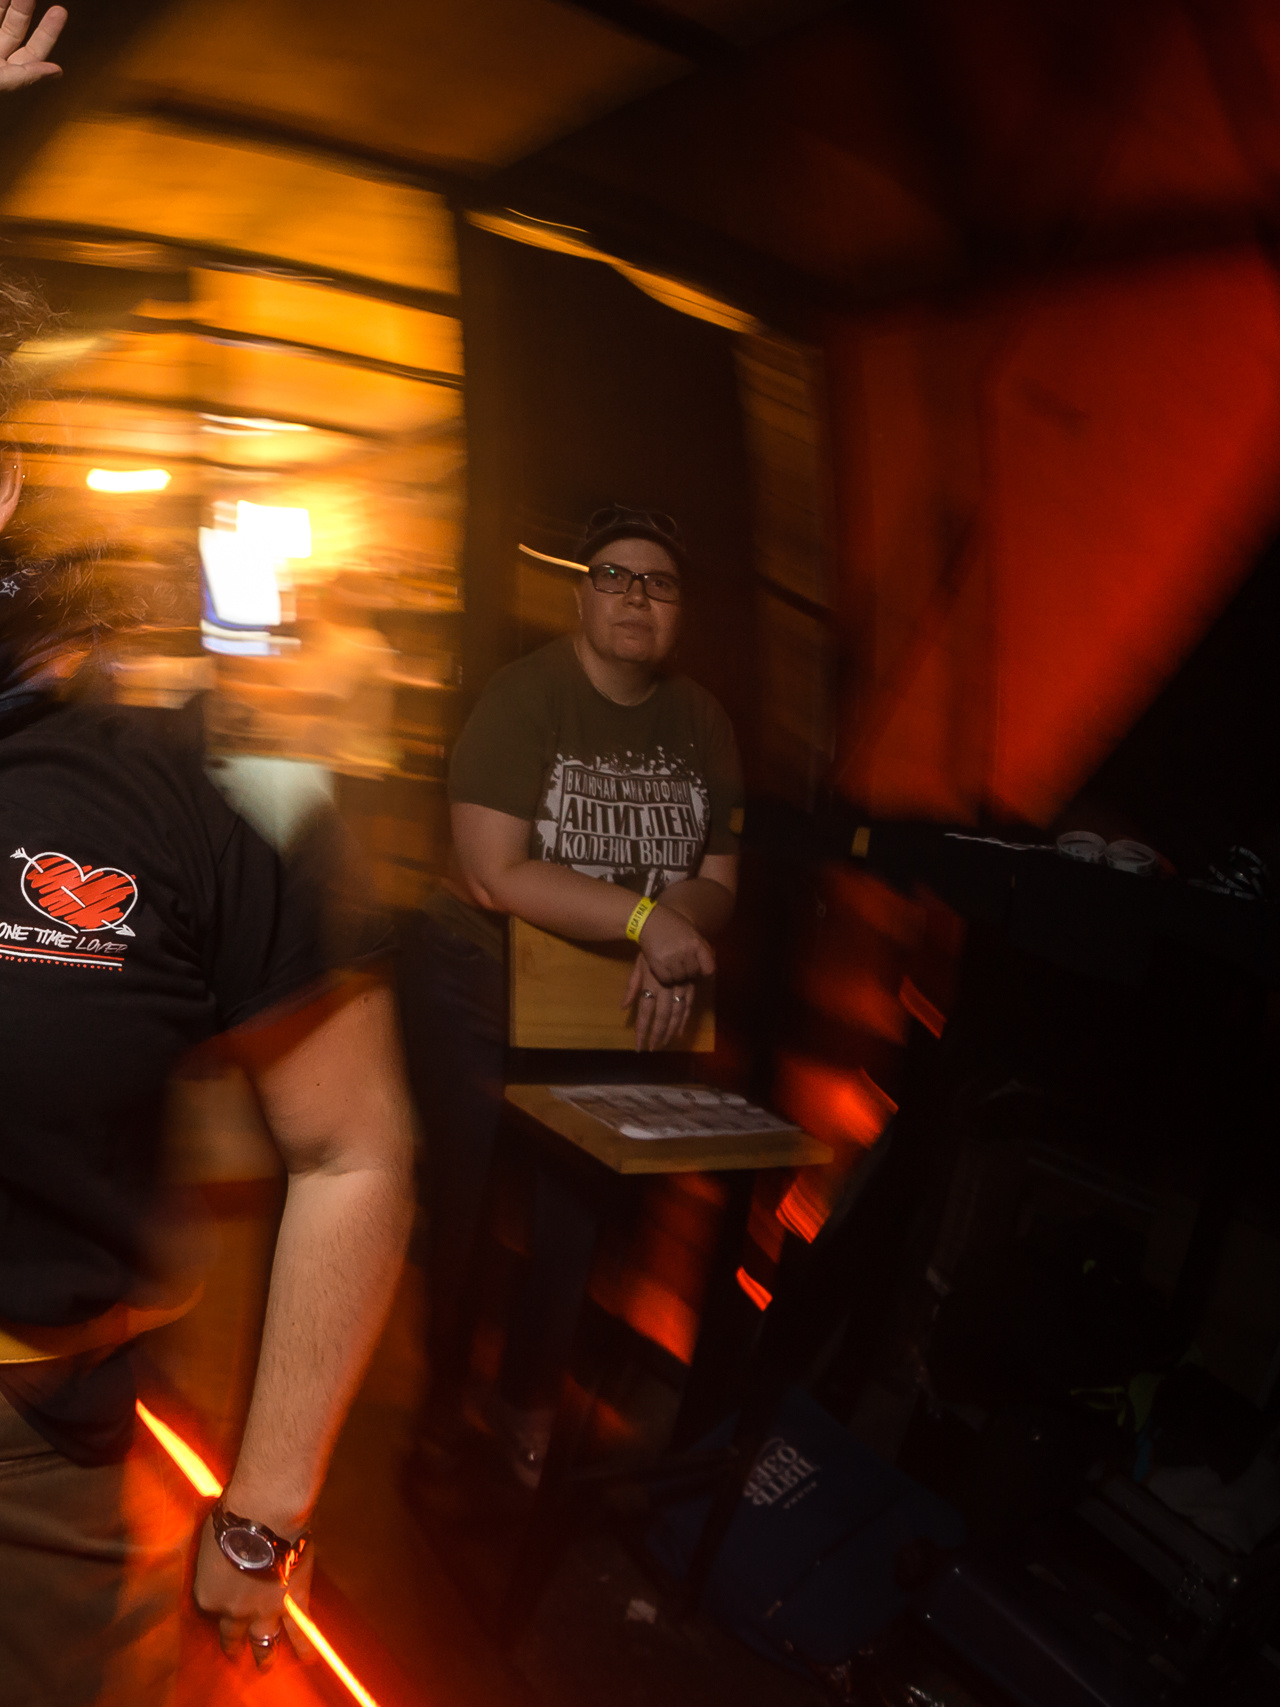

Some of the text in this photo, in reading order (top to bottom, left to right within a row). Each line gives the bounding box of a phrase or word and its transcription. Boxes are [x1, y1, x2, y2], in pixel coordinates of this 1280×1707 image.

[566, 769, 618, 801] ВКЛЮЧАЙ
[563, 797, 698, 838] АНТИТЛЕН
[560, 832, 633, 865] КОЛЕНИ
[34, 927, 77, 949] TIME
[75, 936, 128, 953] LOVER
